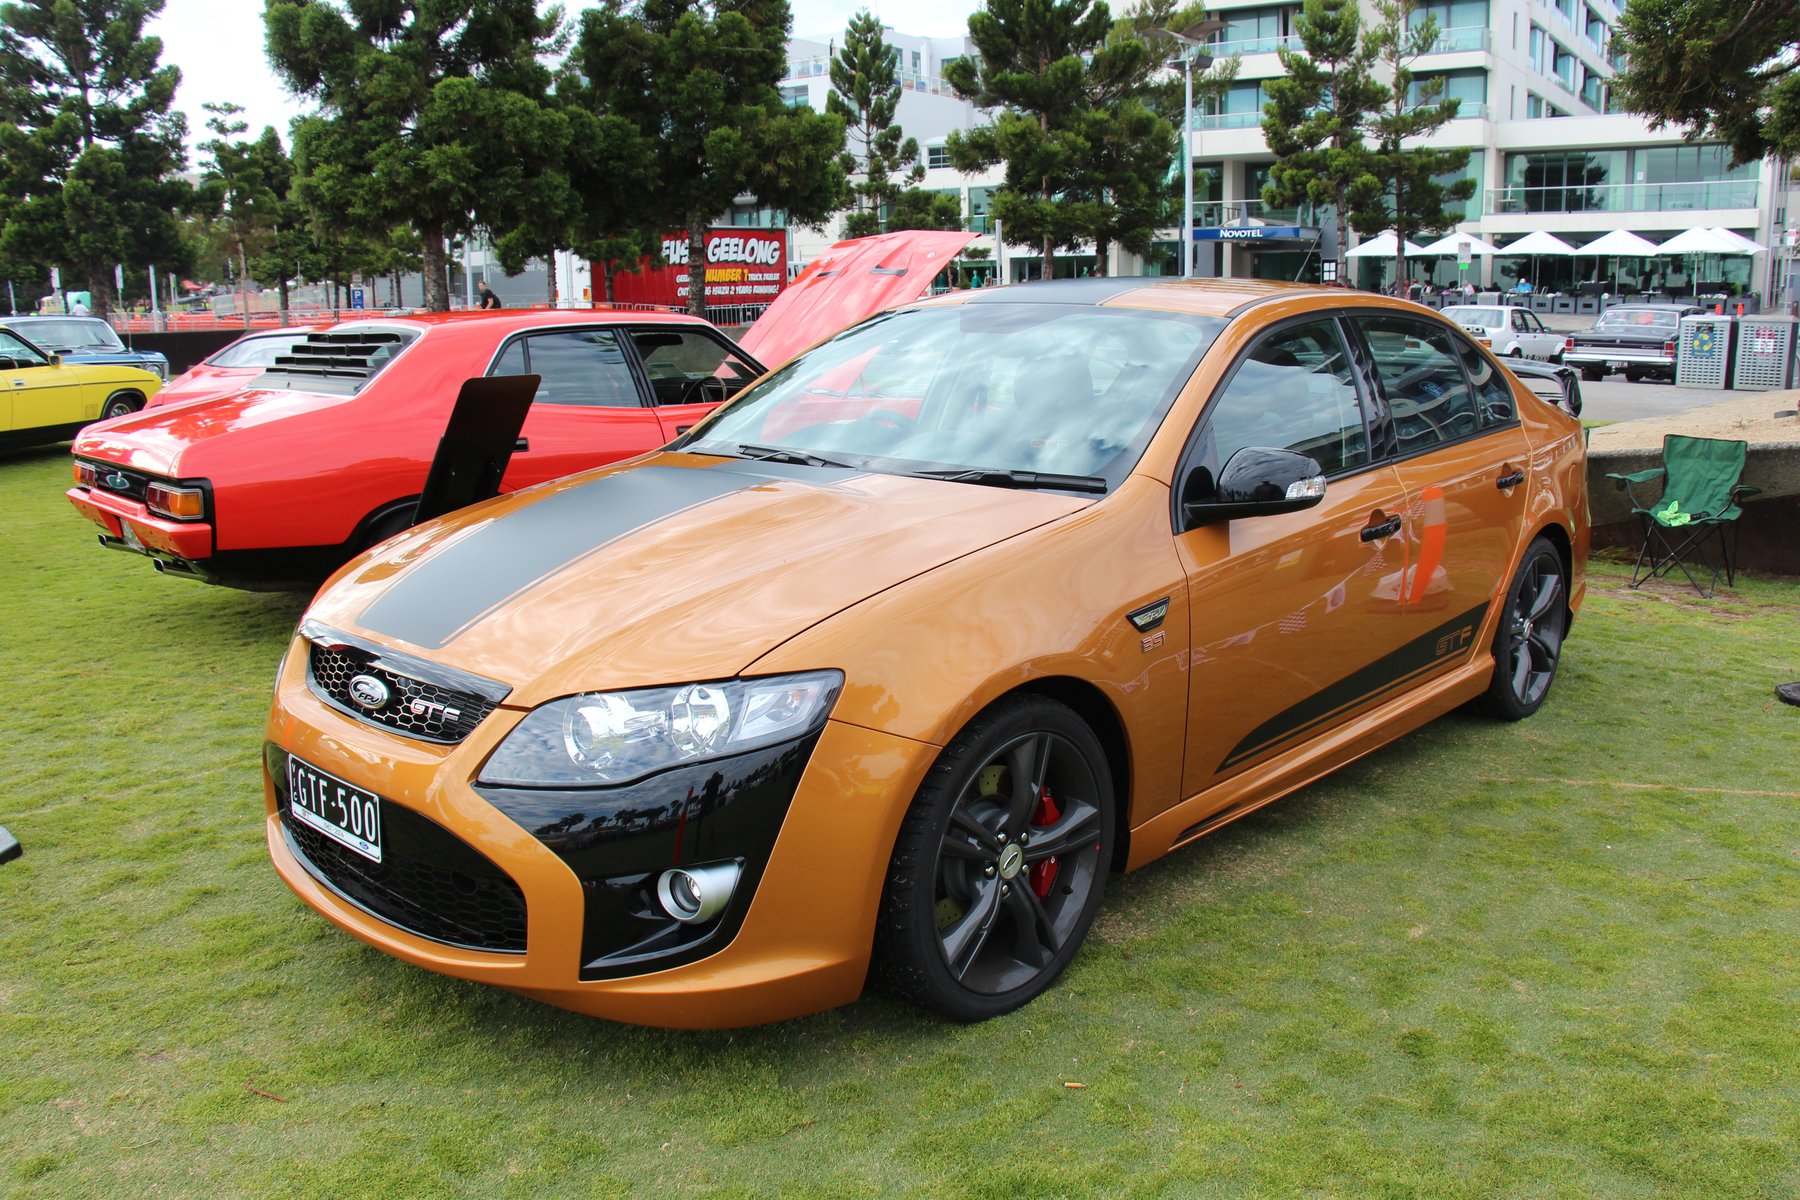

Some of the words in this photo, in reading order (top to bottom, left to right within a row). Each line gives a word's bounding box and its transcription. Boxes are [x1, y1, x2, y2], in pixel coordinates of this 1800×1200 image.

[1220, 229, 1263, 238] NOVOTEL
[662, 239, 689, 265] FUS
[707, 237, 780, 265] GEELONG
[705, 269, 741, 283] NUMBER
[742, 269, 749, 282] 1
[748, 273, 762, 281] TRUCK
[354, 290, 361, 299] P
[712, 286, 730, 295] ISUZU
[730, 286, 735, 295] 2
[736, 286, 752, 295] YEARS
[753, 285, 779, 294] RUNNING!
